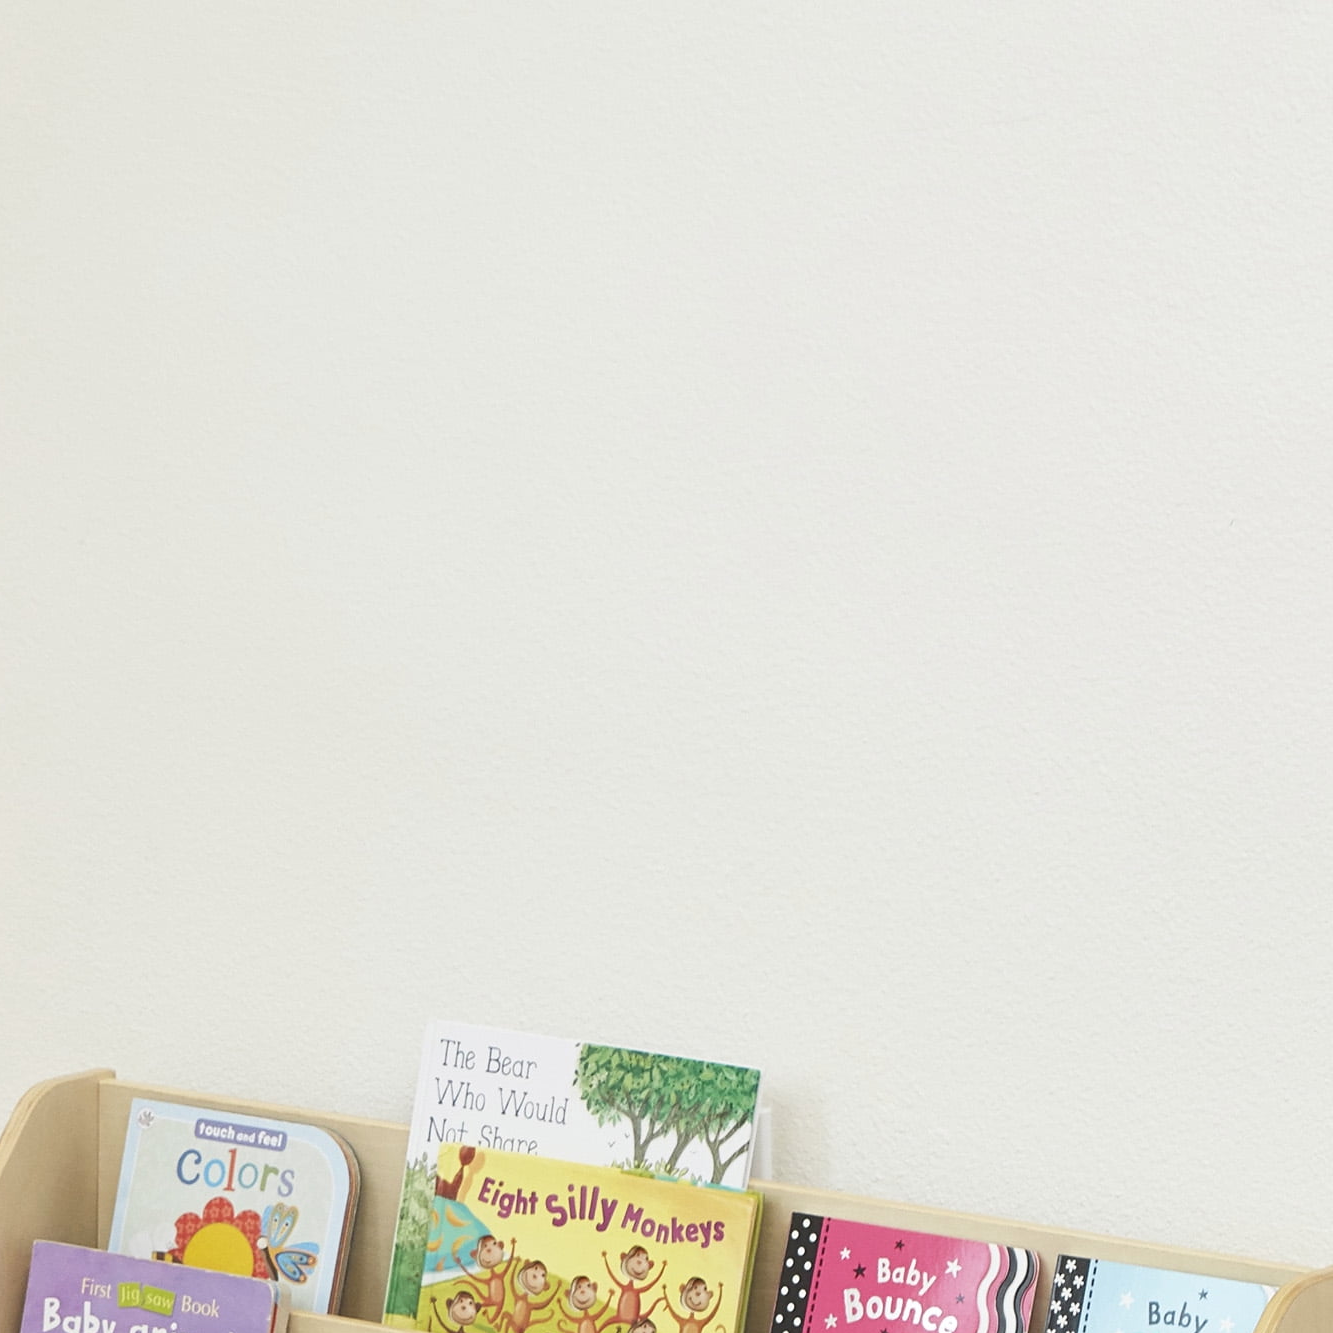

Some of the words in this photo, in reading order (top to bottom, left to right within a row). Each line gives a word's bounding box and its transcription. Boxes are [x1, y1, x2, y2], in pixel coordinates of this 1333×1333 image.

[440, 1038, 476, 1071] The
[485, 1046, 538, 1080] Bear
[435, 1077, 486, 1112] Who
[498, 1087, 569, 1125] Would
[199, 1121, 235, 1140] touch
[236, 1132, 256, 1144] and
[257, 1131, 283, 1148] feel
[426, 1116, 468, 1143] Not
[176, 1148, 295, 1198] Colors
[478, 1177, 539, 1219] Eight
[545, 1184, 618, 1233] Silly
[620, 1203, 726, 1249] Monkeys
[81, 1277, 112, 1300] First
[181, 1295, 220, 1318] Book
[877, 1257, 937, 1297] Baby
